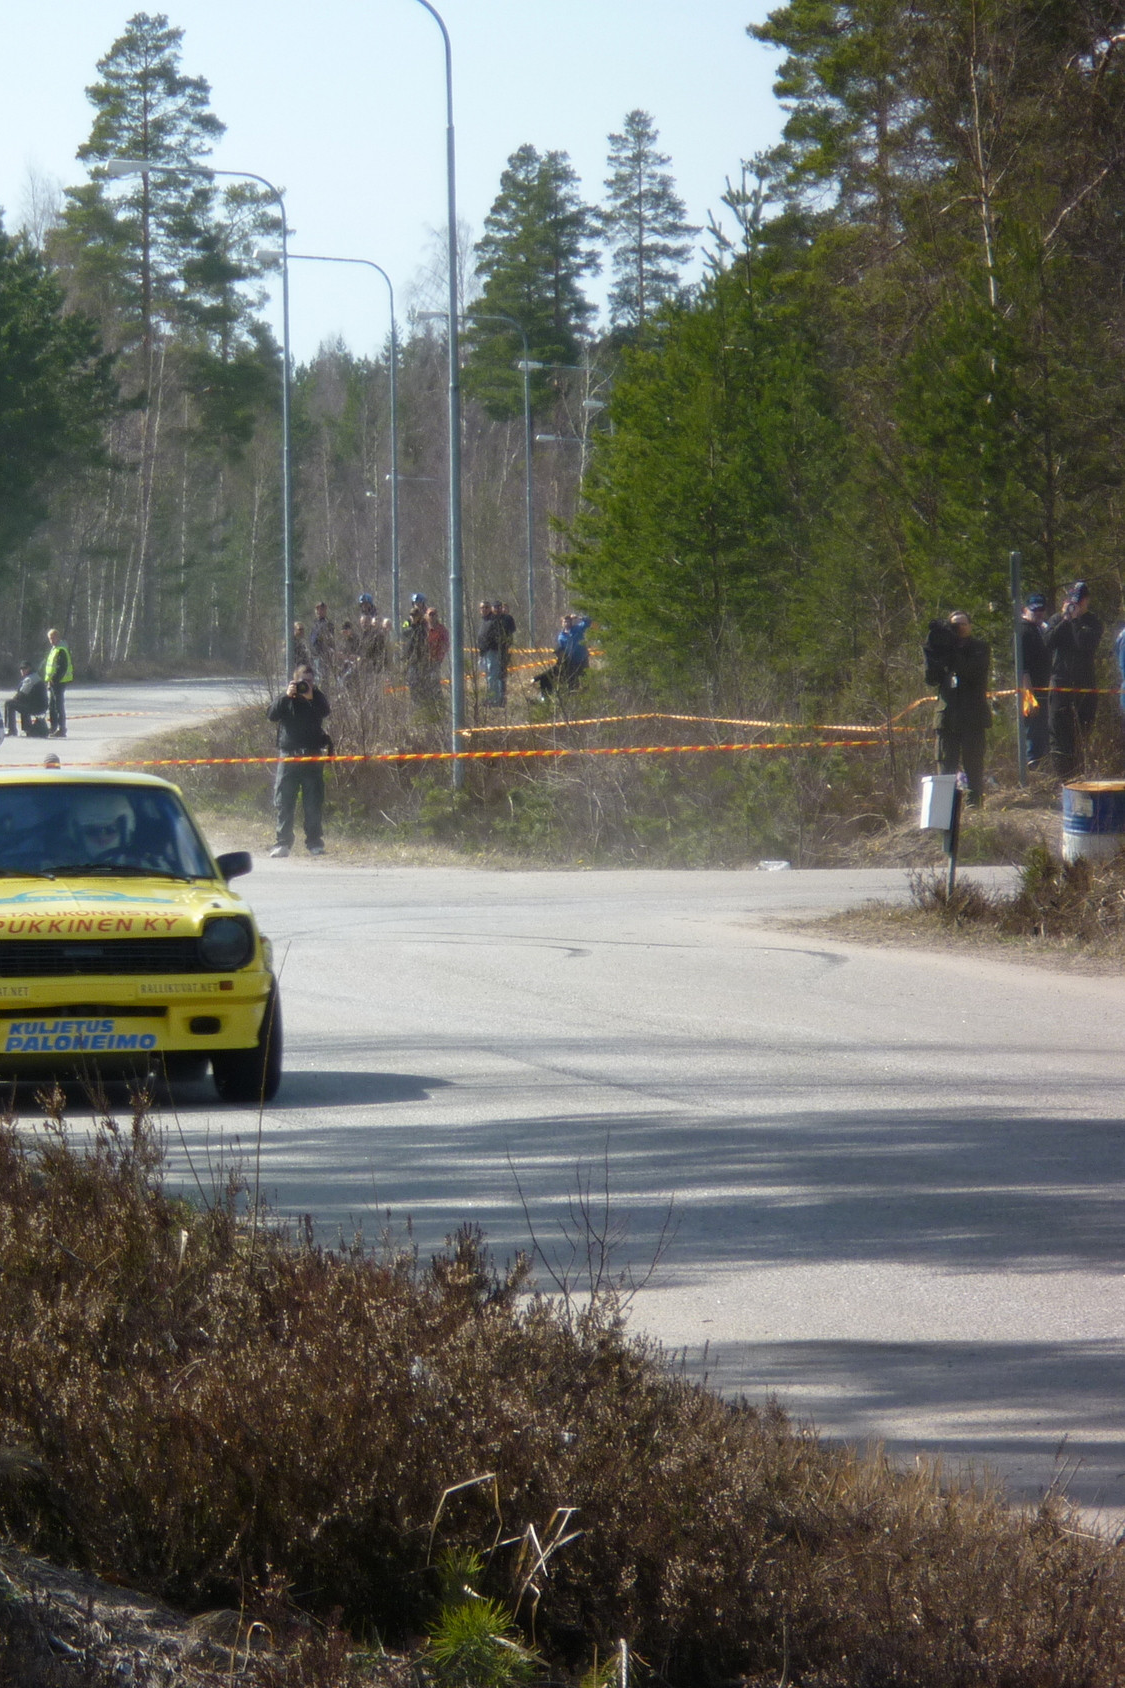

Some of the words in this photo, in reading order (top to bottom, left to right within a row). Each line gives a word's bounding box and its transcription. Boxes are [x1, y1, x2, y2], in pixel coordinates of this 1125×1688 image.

[143, 918, 179, 932] KY
[9, 1020, 114, 1035] KULJETUS
[5, 1034, 157, 1051] PALOHEIMO
